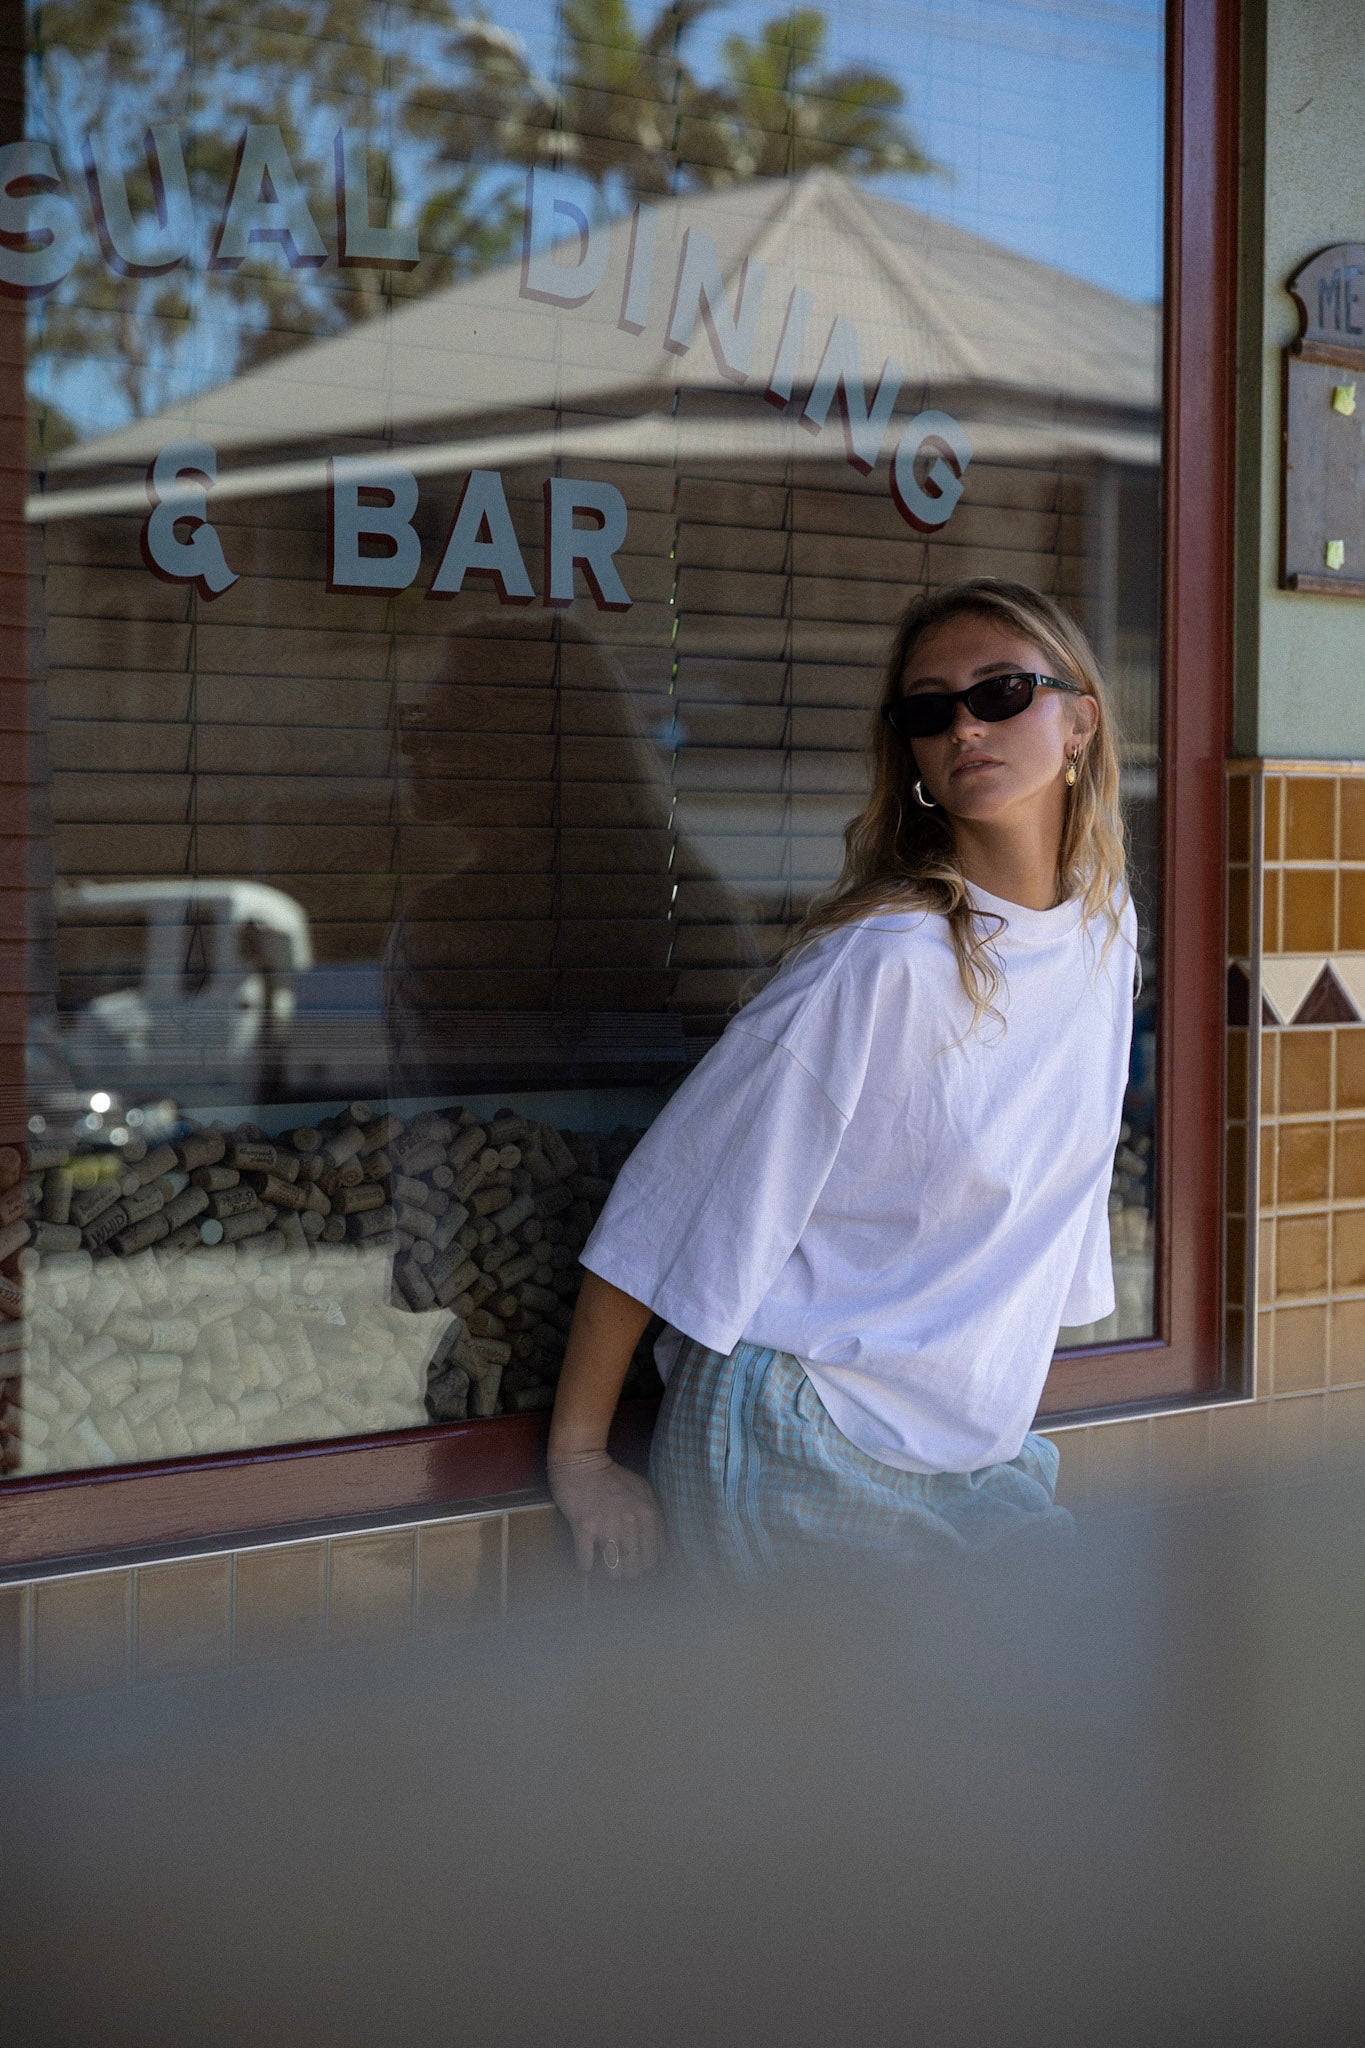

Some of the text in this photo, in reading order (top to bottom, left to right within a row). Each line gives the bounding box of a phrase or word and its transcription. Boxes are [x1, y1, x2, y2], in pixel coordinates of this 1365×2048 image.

[0, 124, 973, 534] SUAL DINING
[140, 438, 634, 613] & BAR
